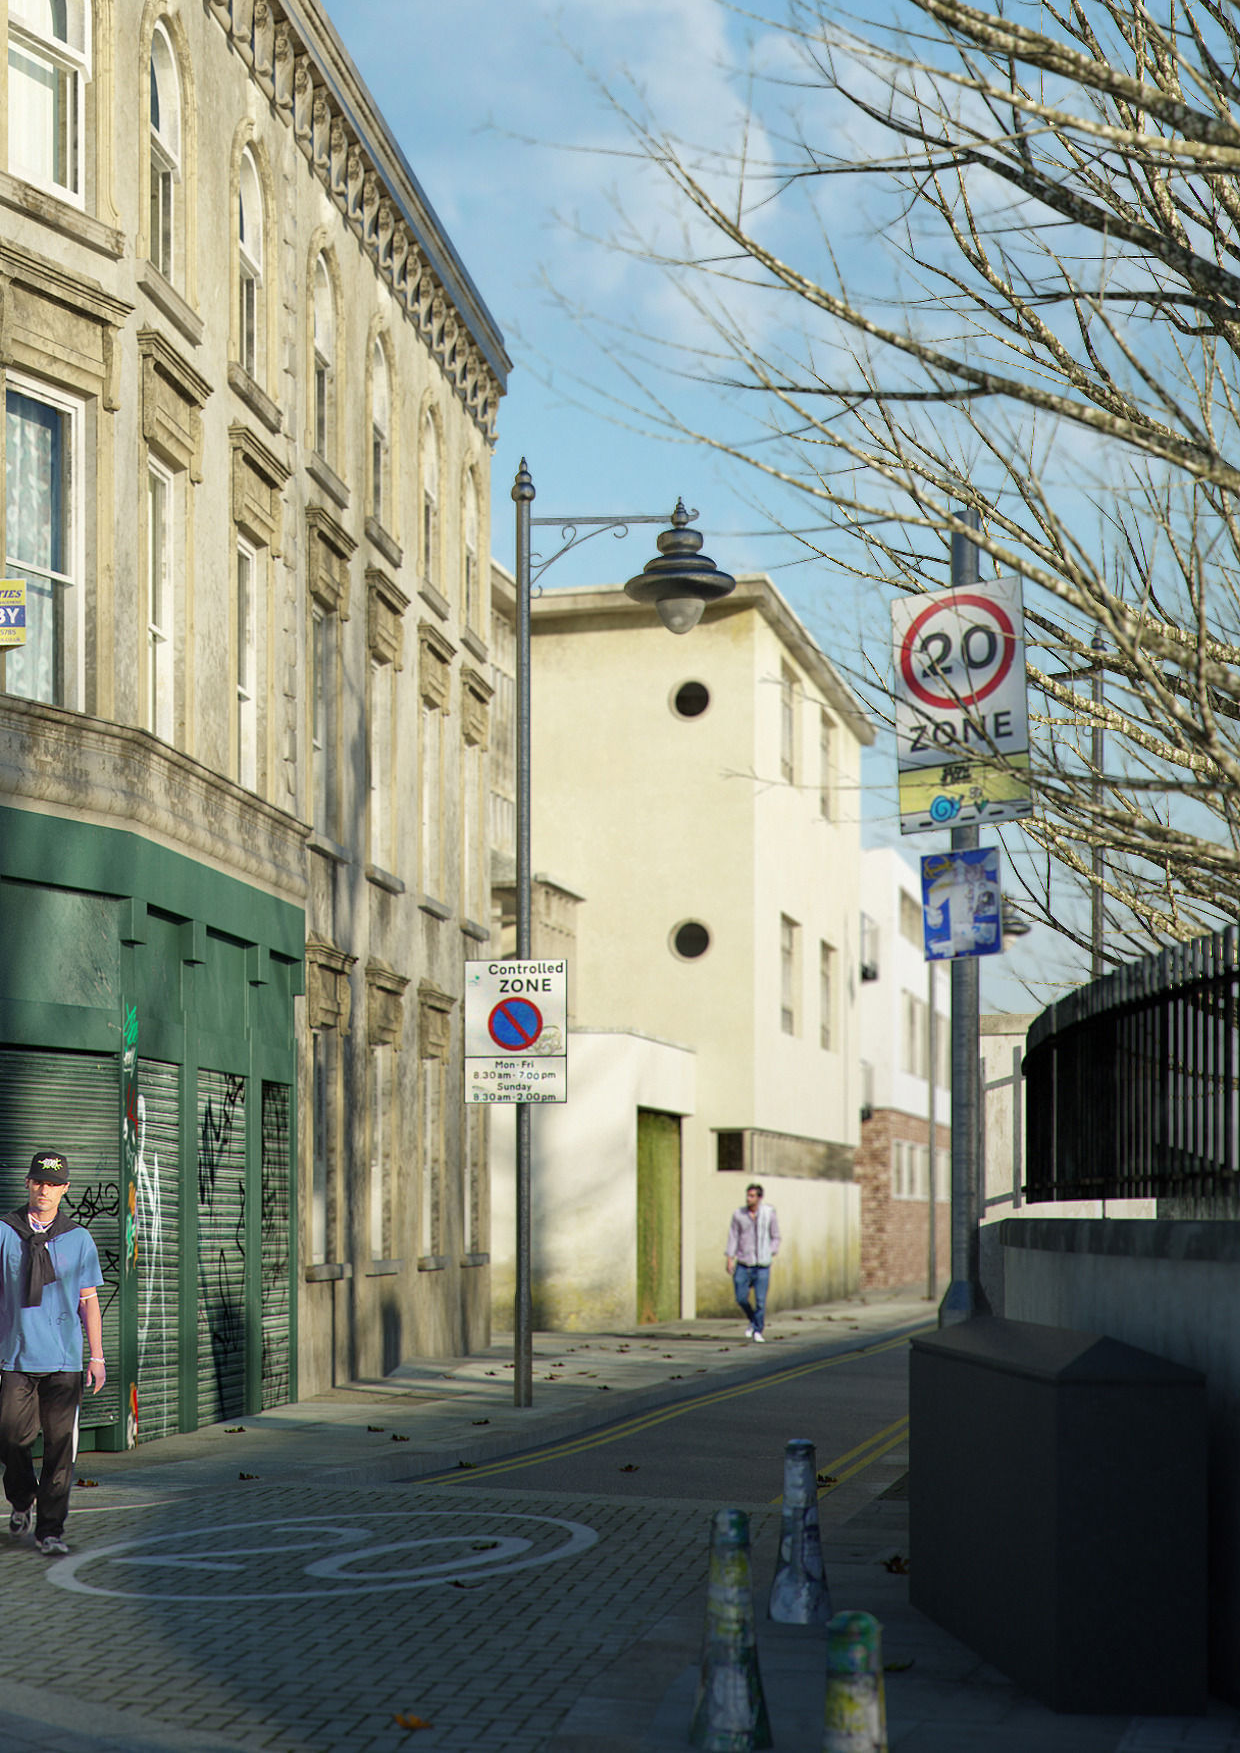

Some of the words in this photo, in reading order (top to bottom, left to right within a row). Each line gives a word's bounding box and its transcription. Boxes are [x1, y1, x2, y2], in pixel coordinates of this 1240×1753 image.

[920, 625, 998, 678] 20
[910, 711, 1014, 753] ZONE
[488, 963, 564, 975] Controlled
[499, 979, 552, 993] ZONE
[496, 1082, 532, 1092] Sunday
